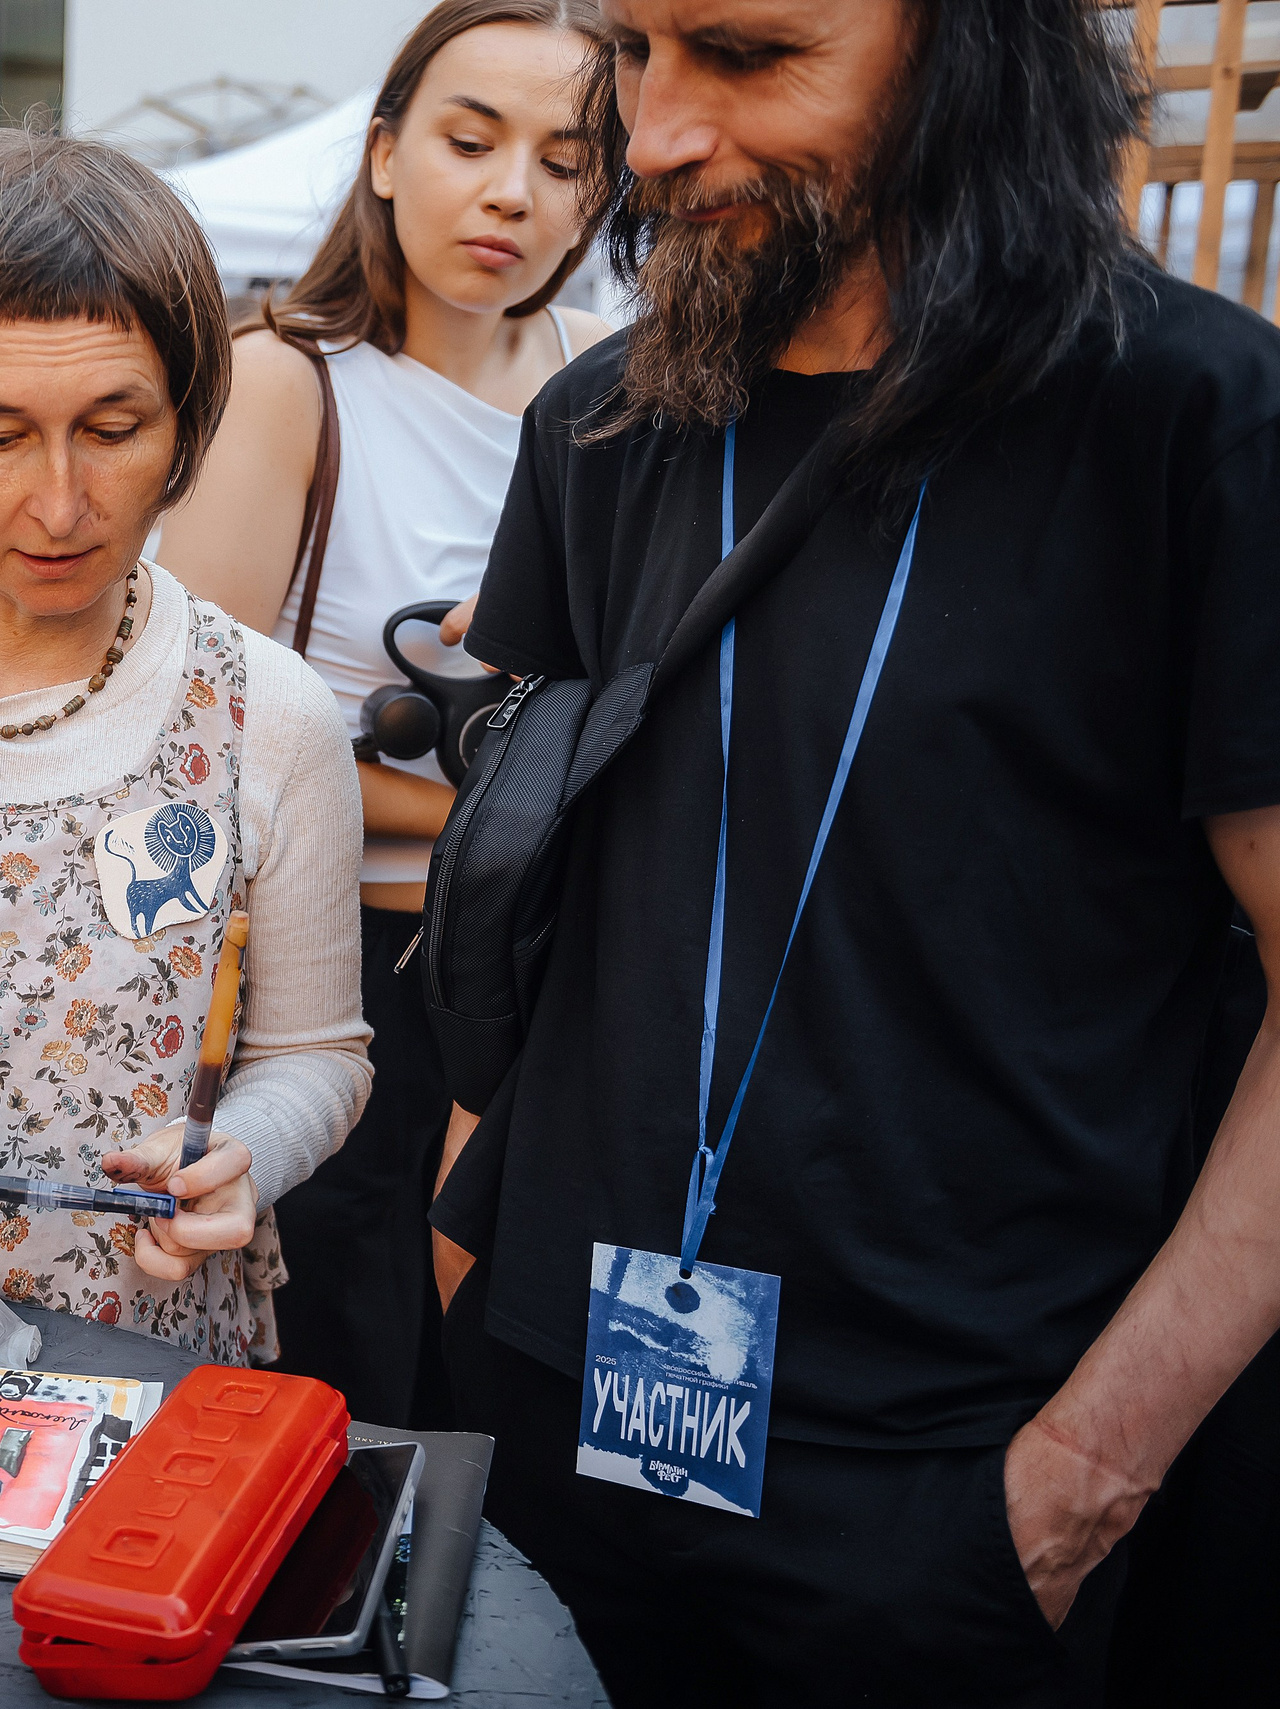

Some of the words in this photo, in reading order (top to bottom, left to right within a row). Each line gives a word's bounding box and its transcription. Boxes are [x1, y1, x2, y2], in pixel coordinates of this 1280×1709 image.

[595, 1354, 617, 1366] 2025
[592, 1367, 751, 1469] УЧАСТНИК
[656, 1470, 682, 1483] ФЕСТ
